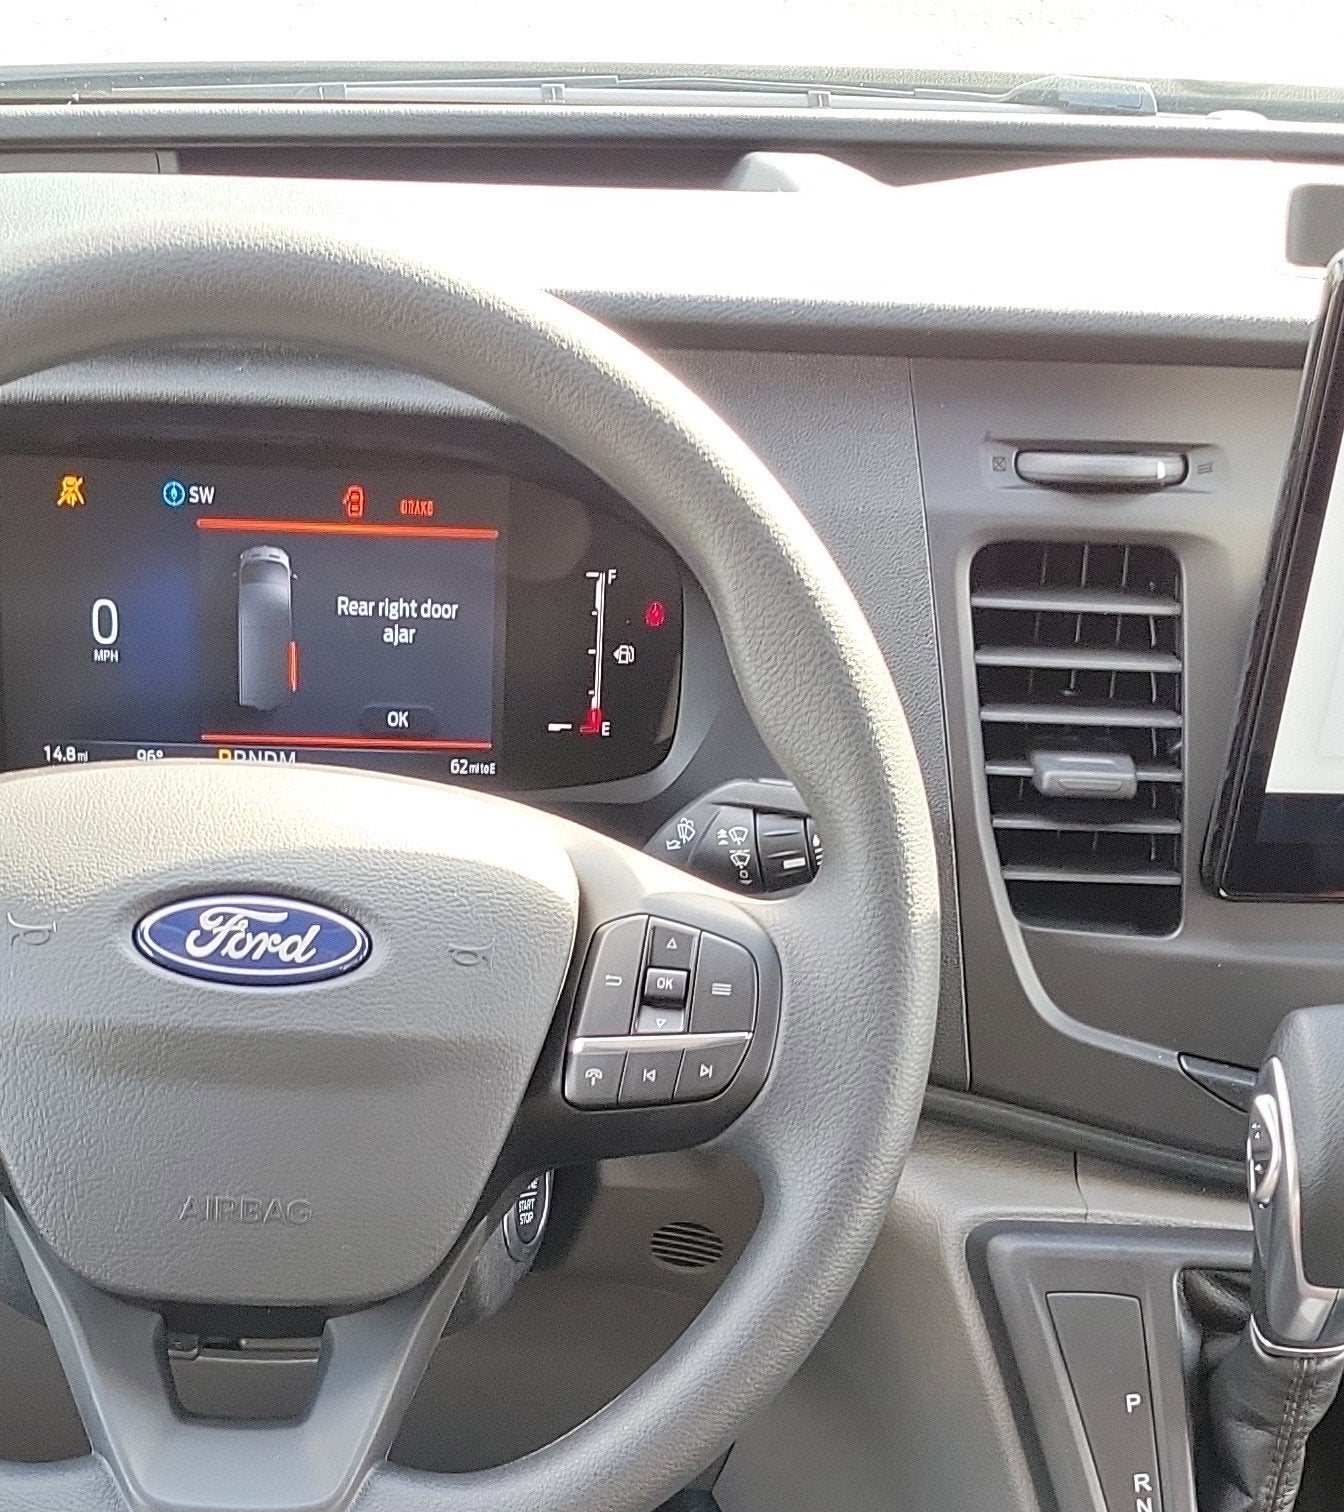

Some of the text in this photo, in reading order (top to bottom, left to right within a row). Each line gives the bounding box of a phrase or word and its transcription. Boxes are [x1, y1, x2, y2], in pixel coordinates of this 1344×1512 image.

[188, 486, 215, 505] SW
[607, 569, 616, 585] F
[337, 596, 459, 620] Rear right door
[91, 598, 119, 645] 0
[383, 623, 416, 646] ajar
[93, 649, 119, 663] MPH
[387, 711, 409, 728] OK
[184, 904, 323, 964] Ford
[656, 976, 674, 990] OK
[178, 1195, 314, 1225] AIRBAG
[518, 1198, 536, 1213] START
[519, 1211, 534, 1225] STOP
[1125, 1393, 1141, 1413] P
[1133, 1473, 1152, 1493] R
